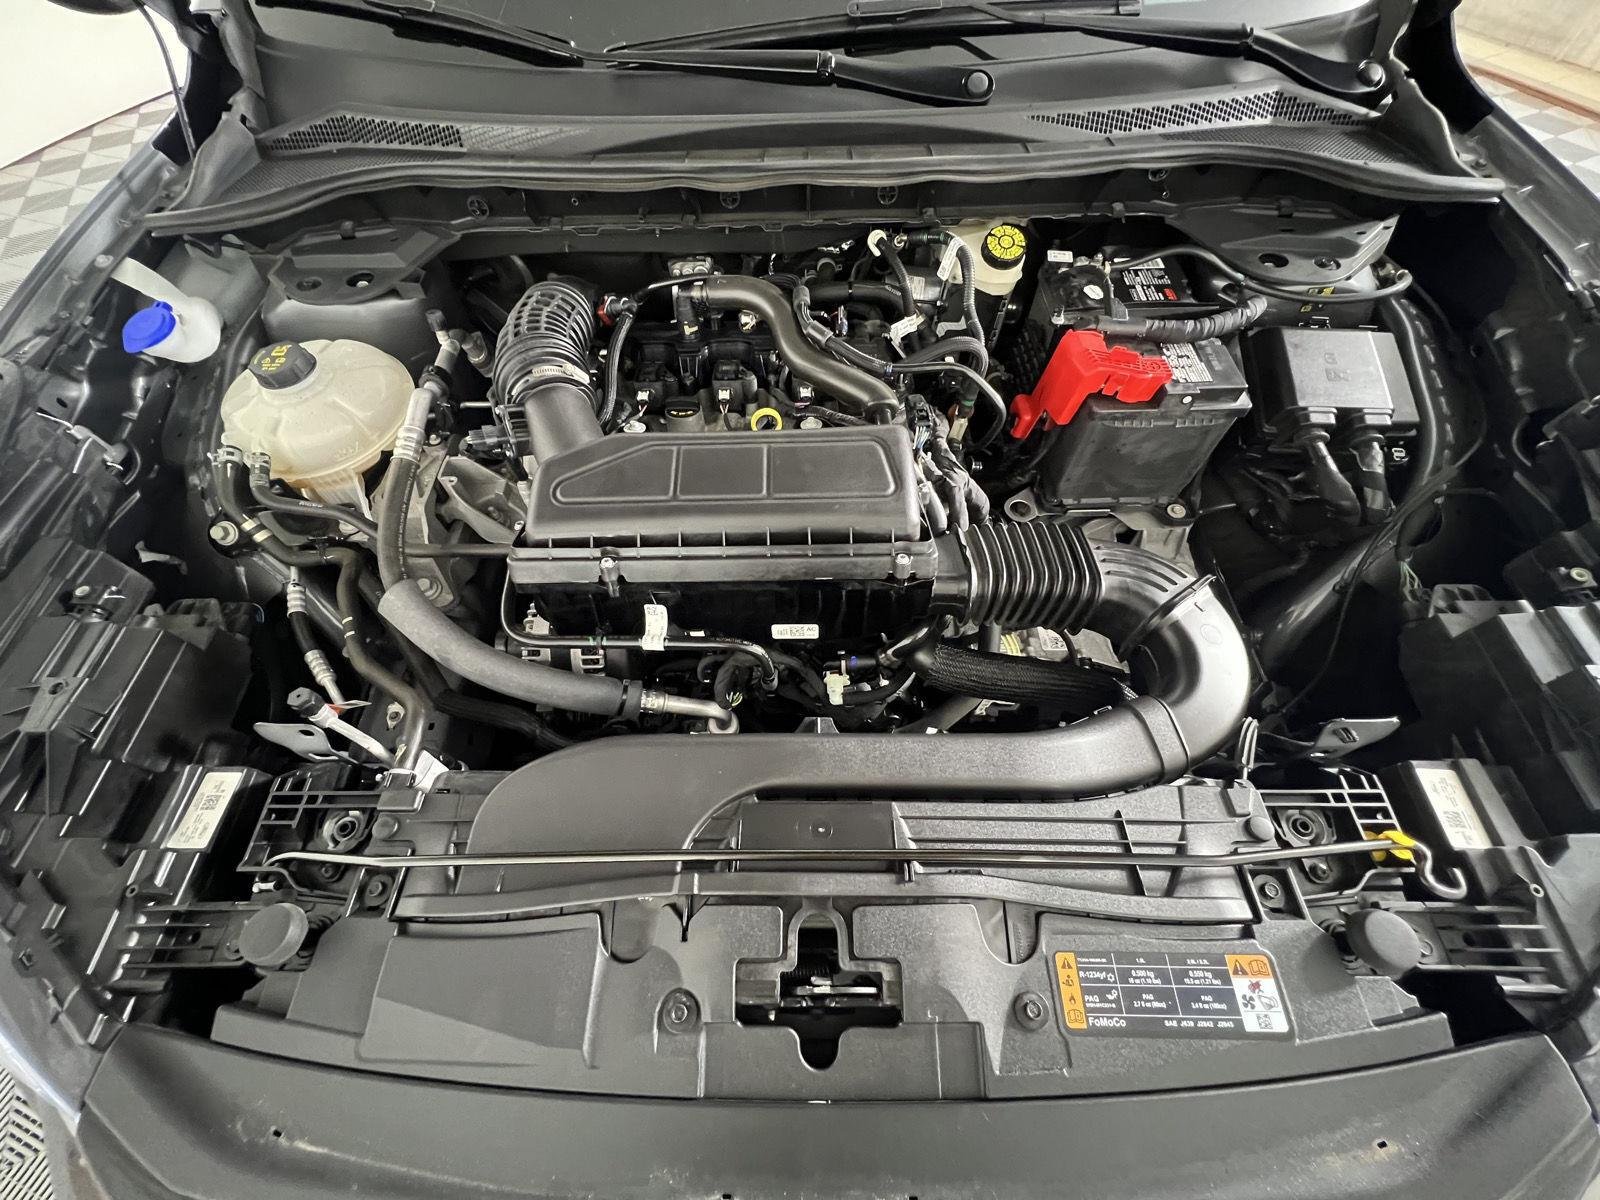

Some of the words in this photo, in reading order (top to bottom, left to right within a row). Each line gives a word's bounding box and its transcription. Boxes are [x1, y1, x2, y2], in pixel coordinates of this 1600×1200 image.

[1079, 970, 1106, 980] R-1234yf
[1146, 969, 1155, 979] kg
[1204, 970, 1213, 979] kg
[1084, 994, 1100, 1002] PAG
[1087, 1016, 1127, 1027] FoMoCo
